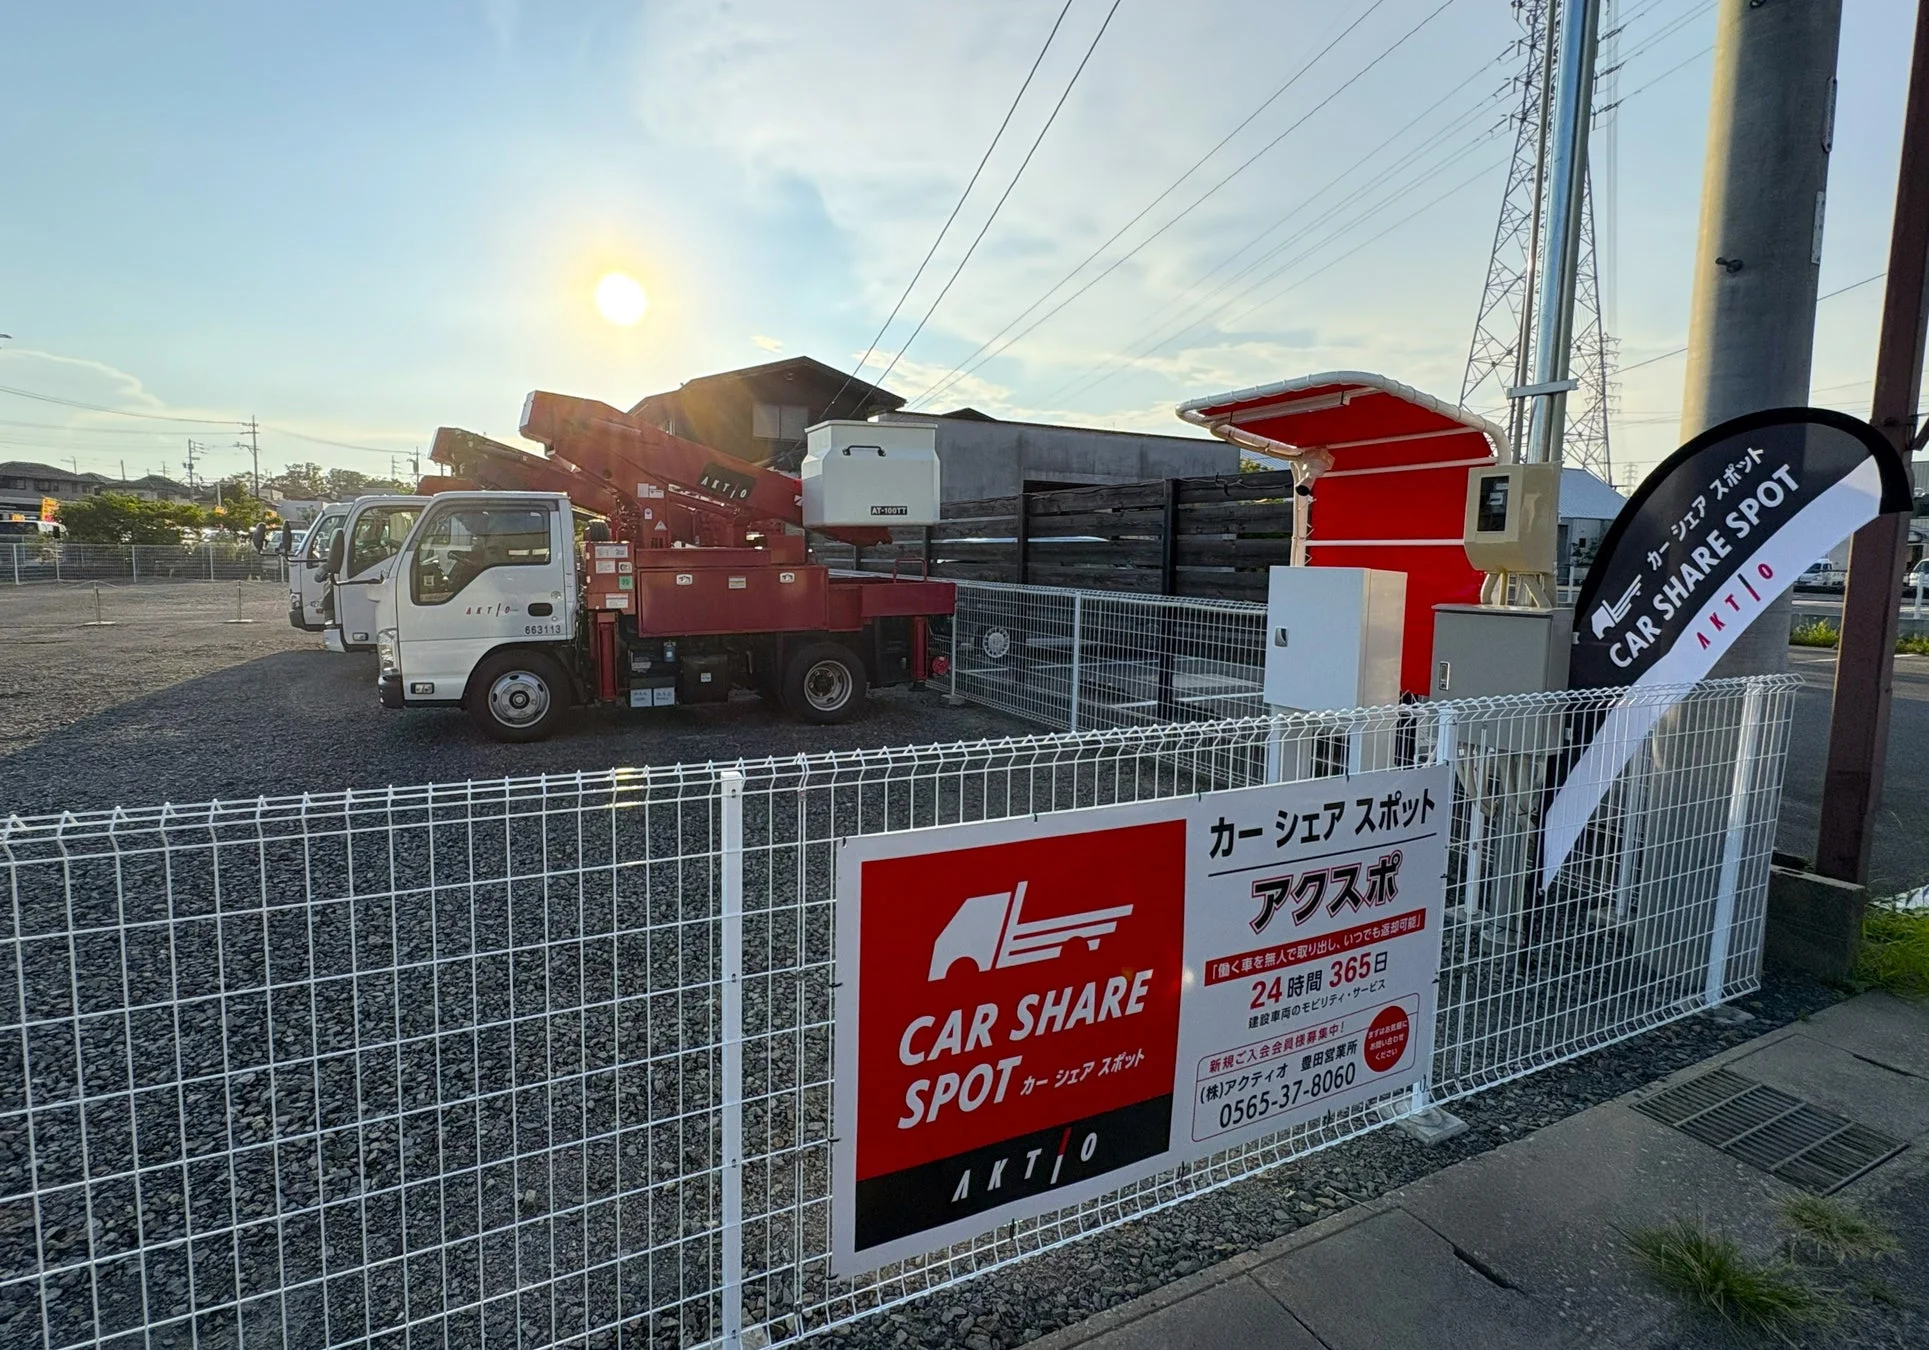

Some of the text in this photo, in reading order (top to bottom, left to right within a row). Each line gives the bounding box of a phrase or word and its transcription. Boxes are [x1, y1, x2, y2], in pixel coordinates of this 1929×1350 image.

[701, 476, 747, 499] AKTIO
[871, 506, 907, 515] AT-100TT
[1647, 446, 1764, 571] カー シェア スポット
[1609, 463, 1800, 668] CAR SHARE SPOT
[466, 603, 510, 617] AKTIO
[525, 625, 561, 635] 663113
[1696, 563, 1774, 650] AKTIO
[1209, 788, 1435, 858] カー シェア スポット
[1249, 850, 1403, 935] アクスポ
[899, 969, 1153, 1066] CAR SHARE
[1249, 978, 1386, 1029] 建設車両のモビリティ・サービス
[1020, 1047, 1145, 1096] カー シェア スポット
[1301, 1039, 1358, 1071] 豊田営業所
[1375, 1048, 1398, 1060] ください
[898, 1055, 1023, 1130] SPOT
[1220, 1062, 1355, 1129] 0565-37-8060
[952, 1127, 1097, 1202] AKTIO
